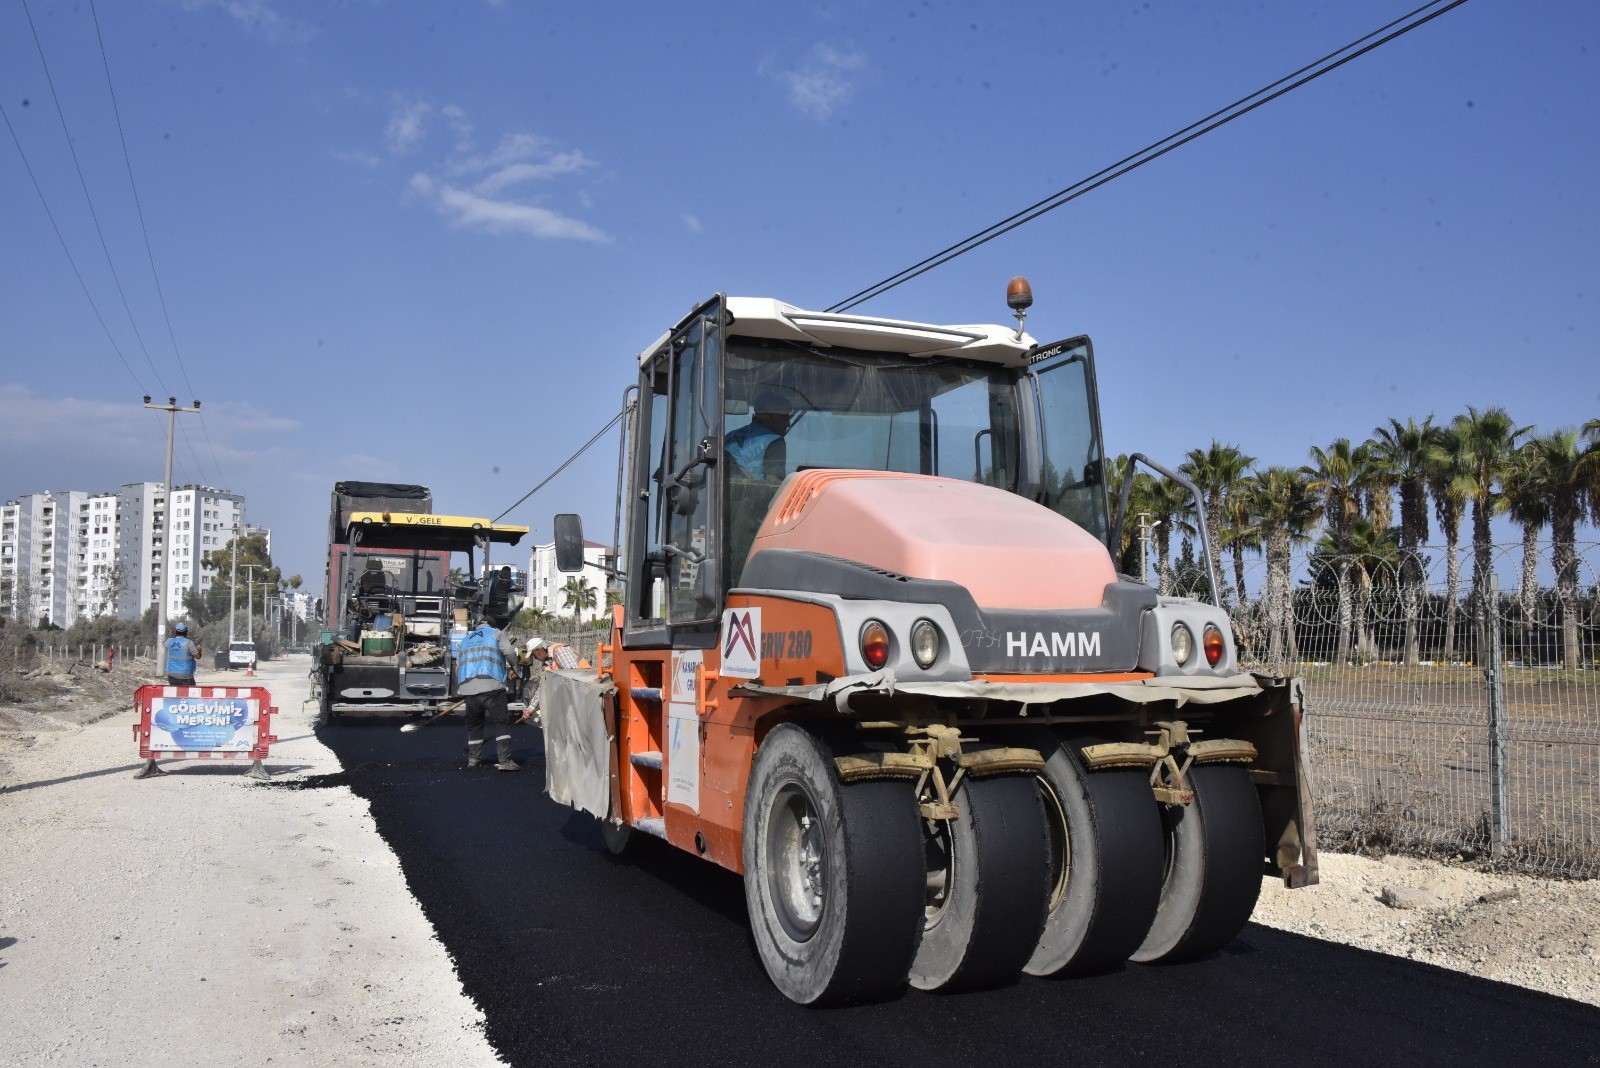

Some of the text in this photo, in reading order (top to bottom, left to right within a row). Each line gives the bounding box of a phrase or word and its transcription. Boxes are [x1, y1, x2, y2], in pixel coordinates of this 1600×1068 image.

[406, 514, 442, 525] VGELE
[788, 630, 813, 659] 280
[1006, 631, 1101, 657] HAMM
[168, 701, 243, 717] GÖREVİMİZ
[176, 714, 231, 726] MERSİN!
